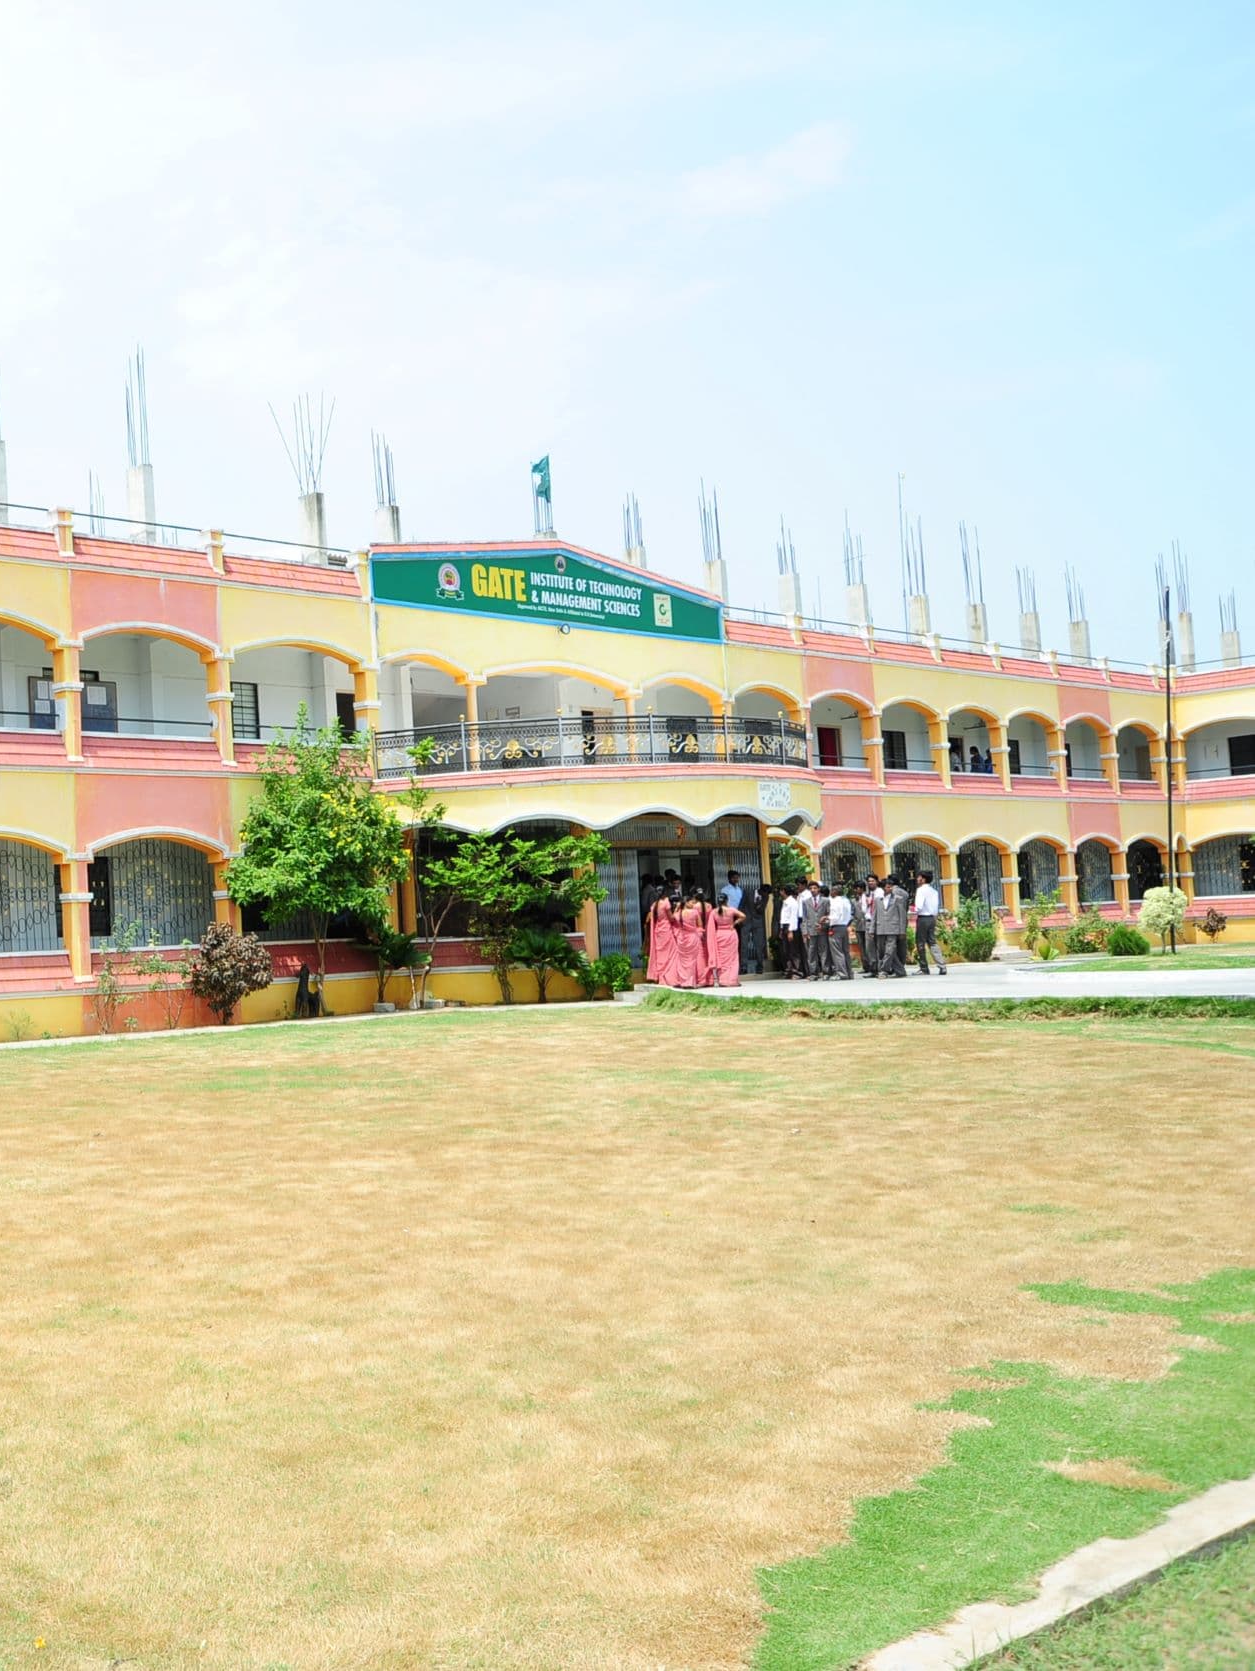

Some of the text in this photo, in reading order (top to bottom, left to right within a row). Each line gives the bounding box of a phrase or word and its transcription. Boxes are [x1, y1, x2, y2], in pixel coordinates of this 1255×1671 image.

[471, 563, 527, 602] GATE
[530, 572, 642, 600] INSTITUTE OF TECHNOLOGY
[531, 590, 539, 603] &
[541, 590, 603, 612] MANAGEMENT
[604, 600, 641, 617] SCIENCES
